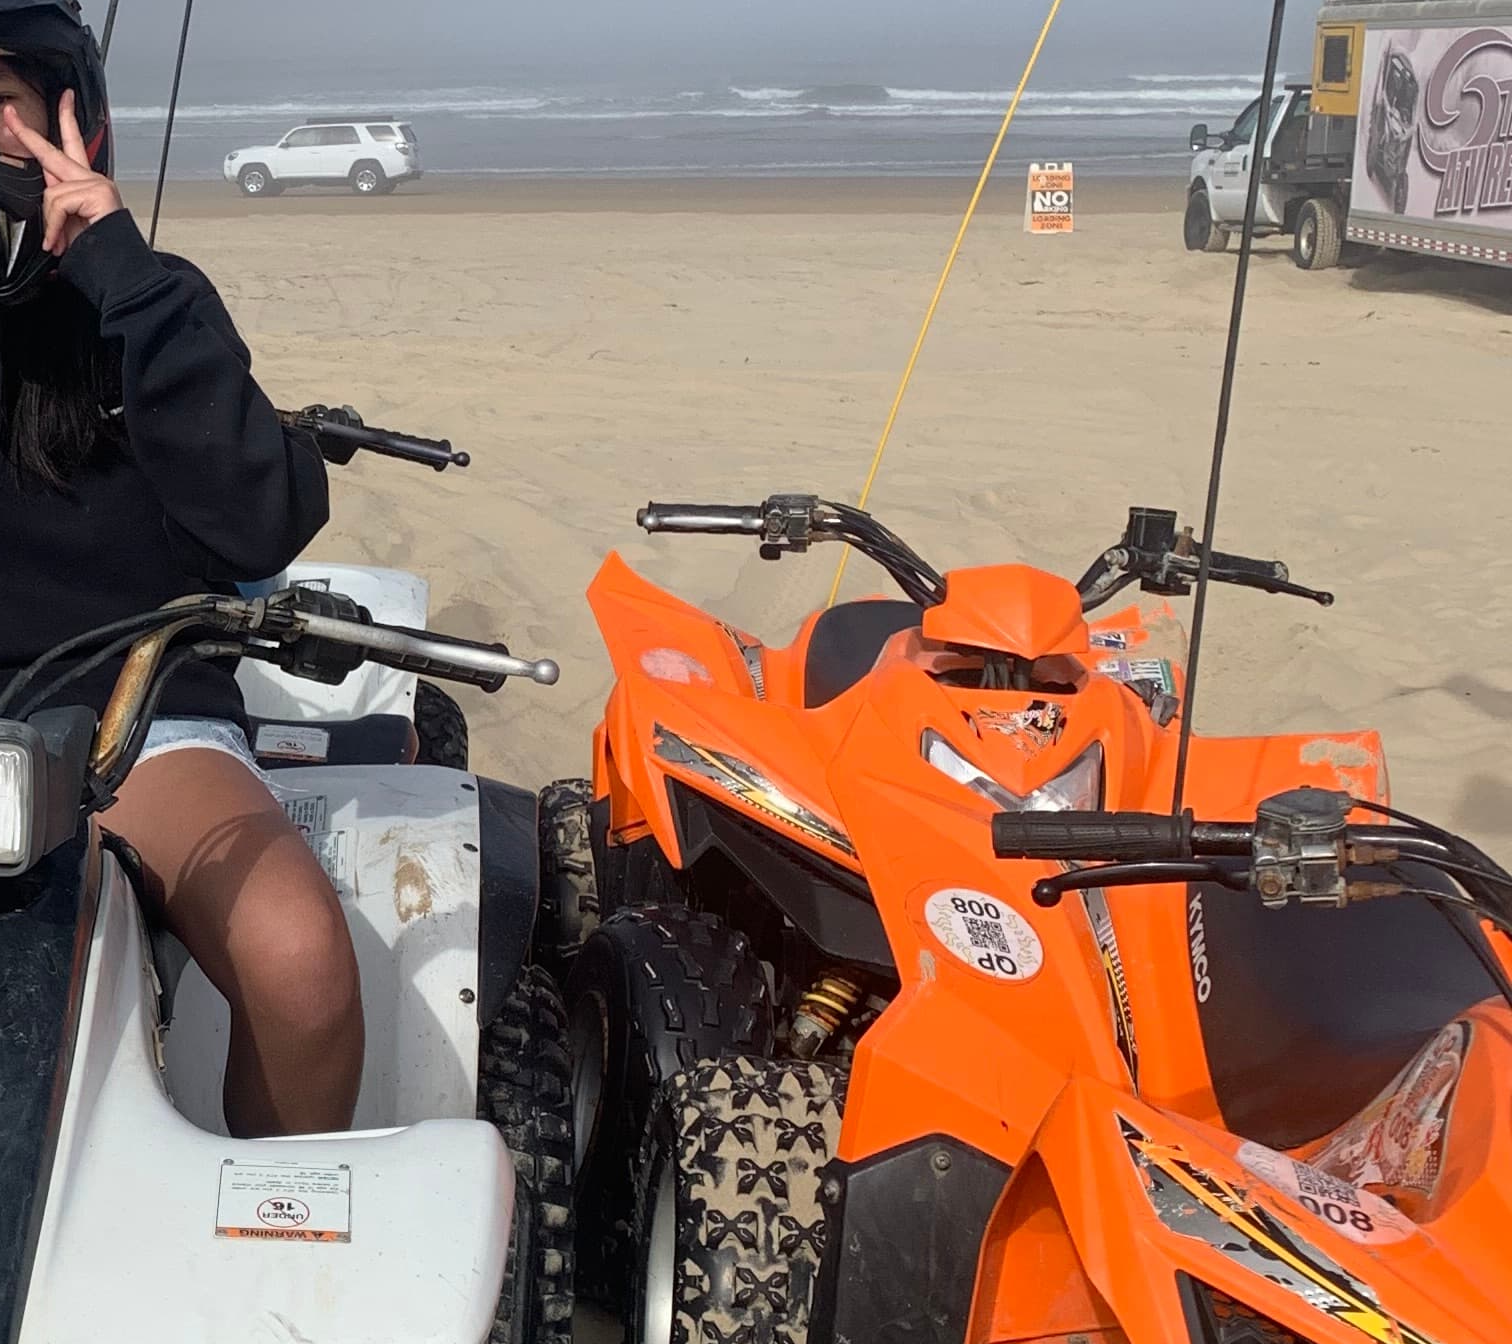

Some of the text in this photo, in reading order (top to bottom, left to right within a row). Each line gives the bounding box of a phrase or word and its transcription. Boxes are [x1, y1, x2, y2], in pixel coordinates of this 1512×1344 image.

[1436, 146, 1490, 213] ATV
[1034, 191, 1069, 207] NO
[1189, 891, 1211, 1003] KYMCO
[978, 952, 1018, 976] QP
[262, 1211, 305, 1221] UNDER
[272, 1201, 295, 1211] 16
[1298, 1195, 1375, 1233] 008
[239, 1229, 308, 1240] WARNING
